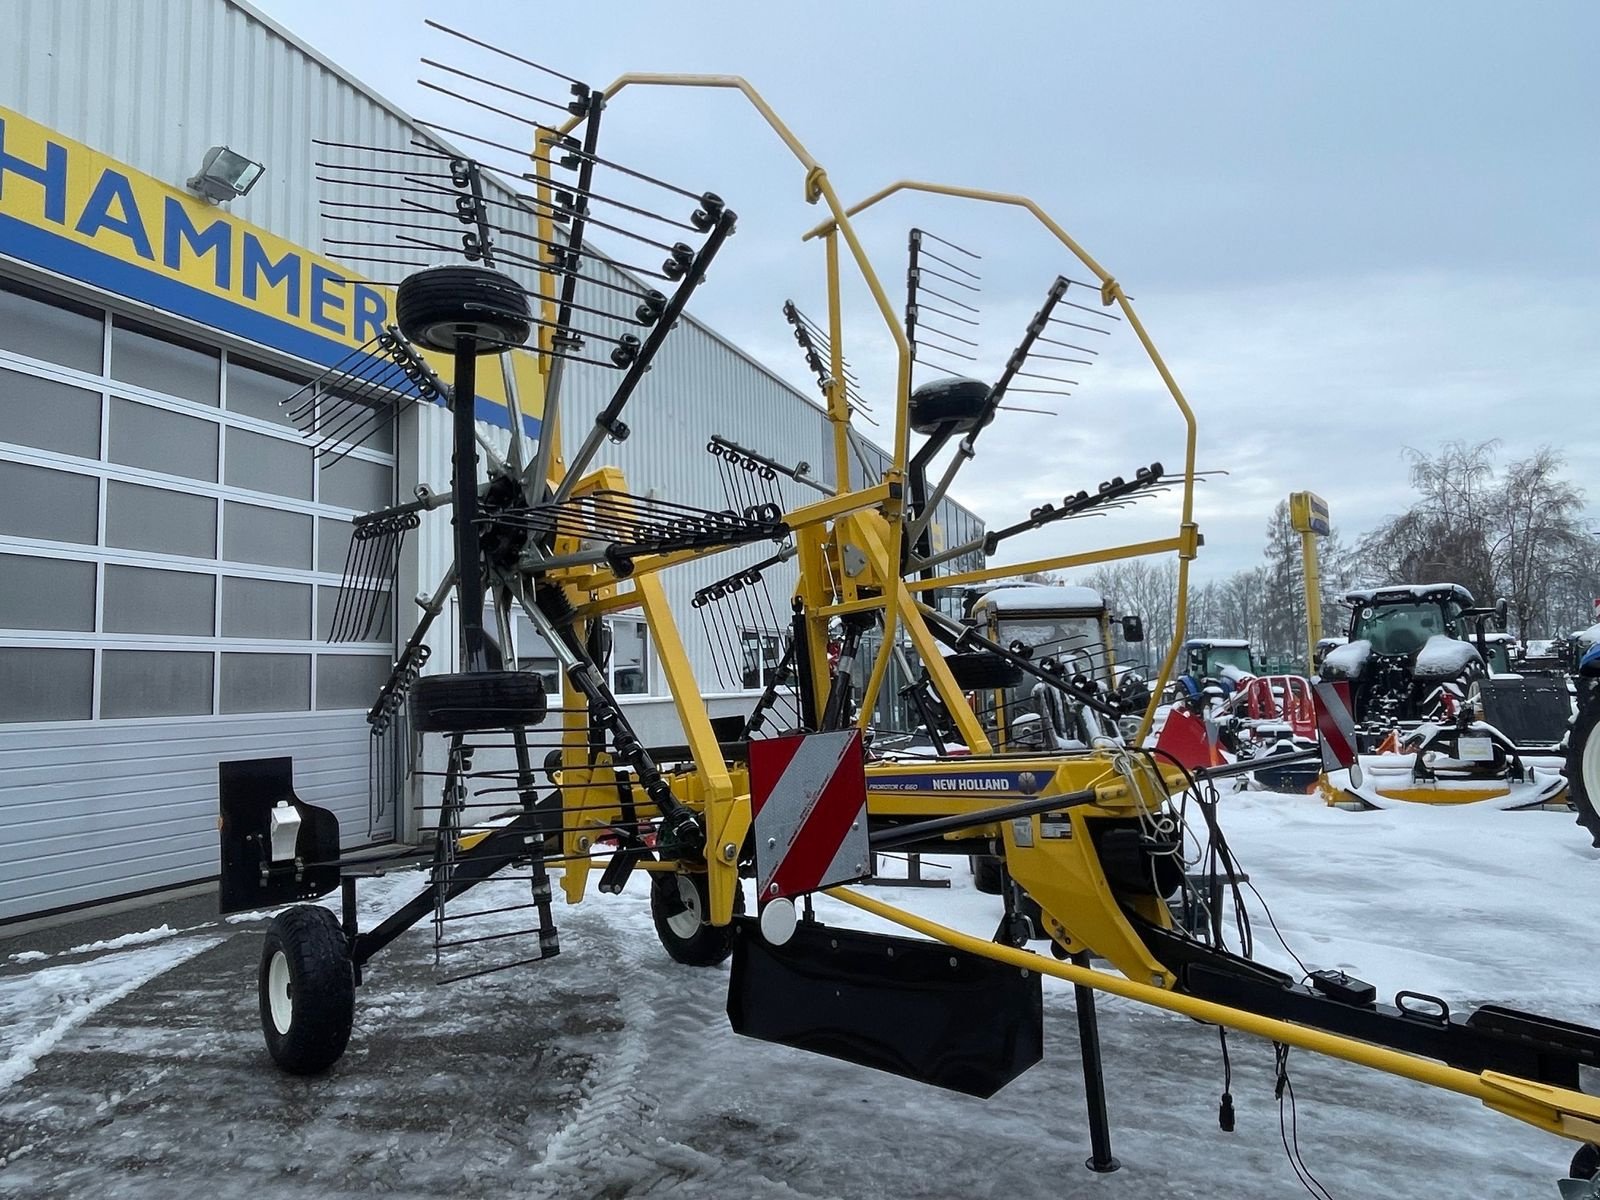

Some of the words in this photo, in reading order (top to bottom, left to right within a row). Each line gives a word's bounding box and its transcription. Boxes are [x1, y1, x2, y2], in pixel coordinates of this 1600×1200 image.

[0, 118, 387, 343] HAMMER
[932, 779, 957, 791] NEW
[958, 779, 1010, 791] HOLLAND
